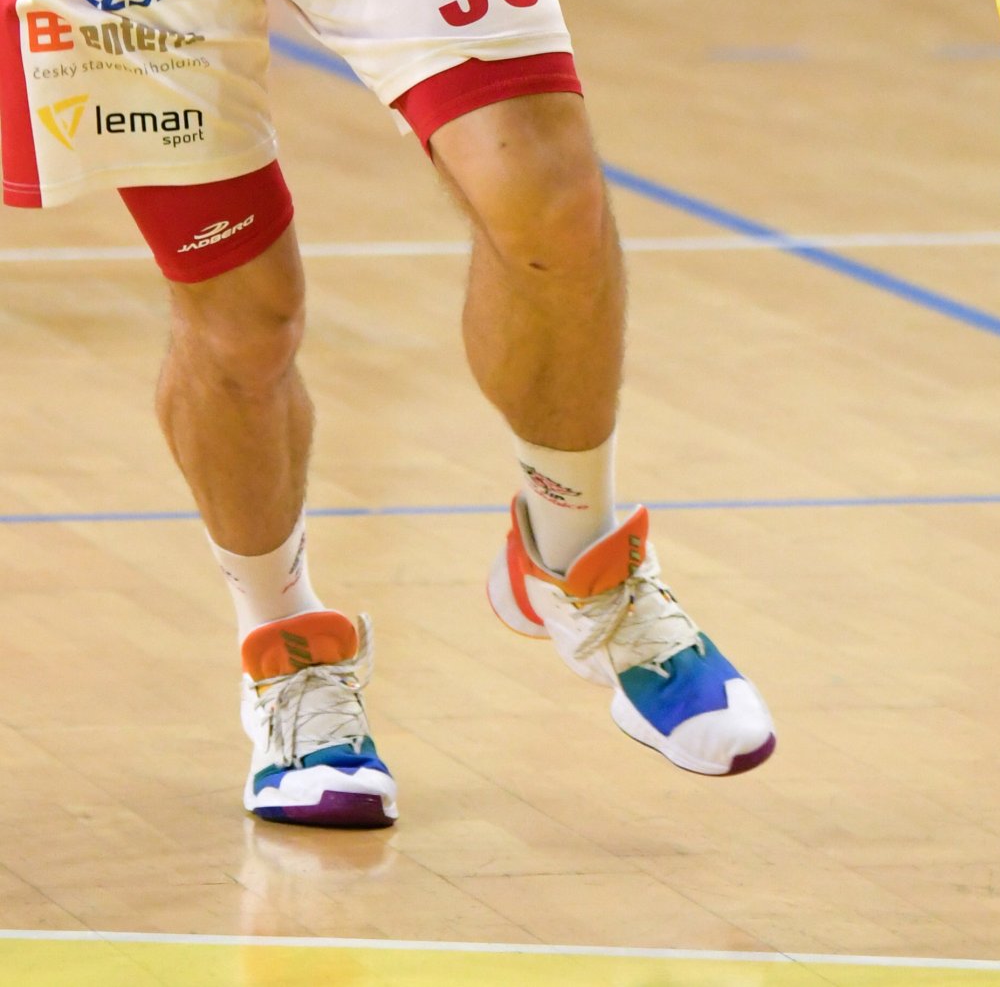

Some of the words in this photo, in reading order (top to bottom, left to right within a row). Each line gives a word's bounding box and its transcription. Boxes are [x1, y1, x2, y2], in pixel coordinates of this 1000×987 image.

[33, 62, 78, 80] český
[95, 105, 204, 135] leman
[162, 128, 205, 148] sport
[177, 214, 255, 254] JADBERG
